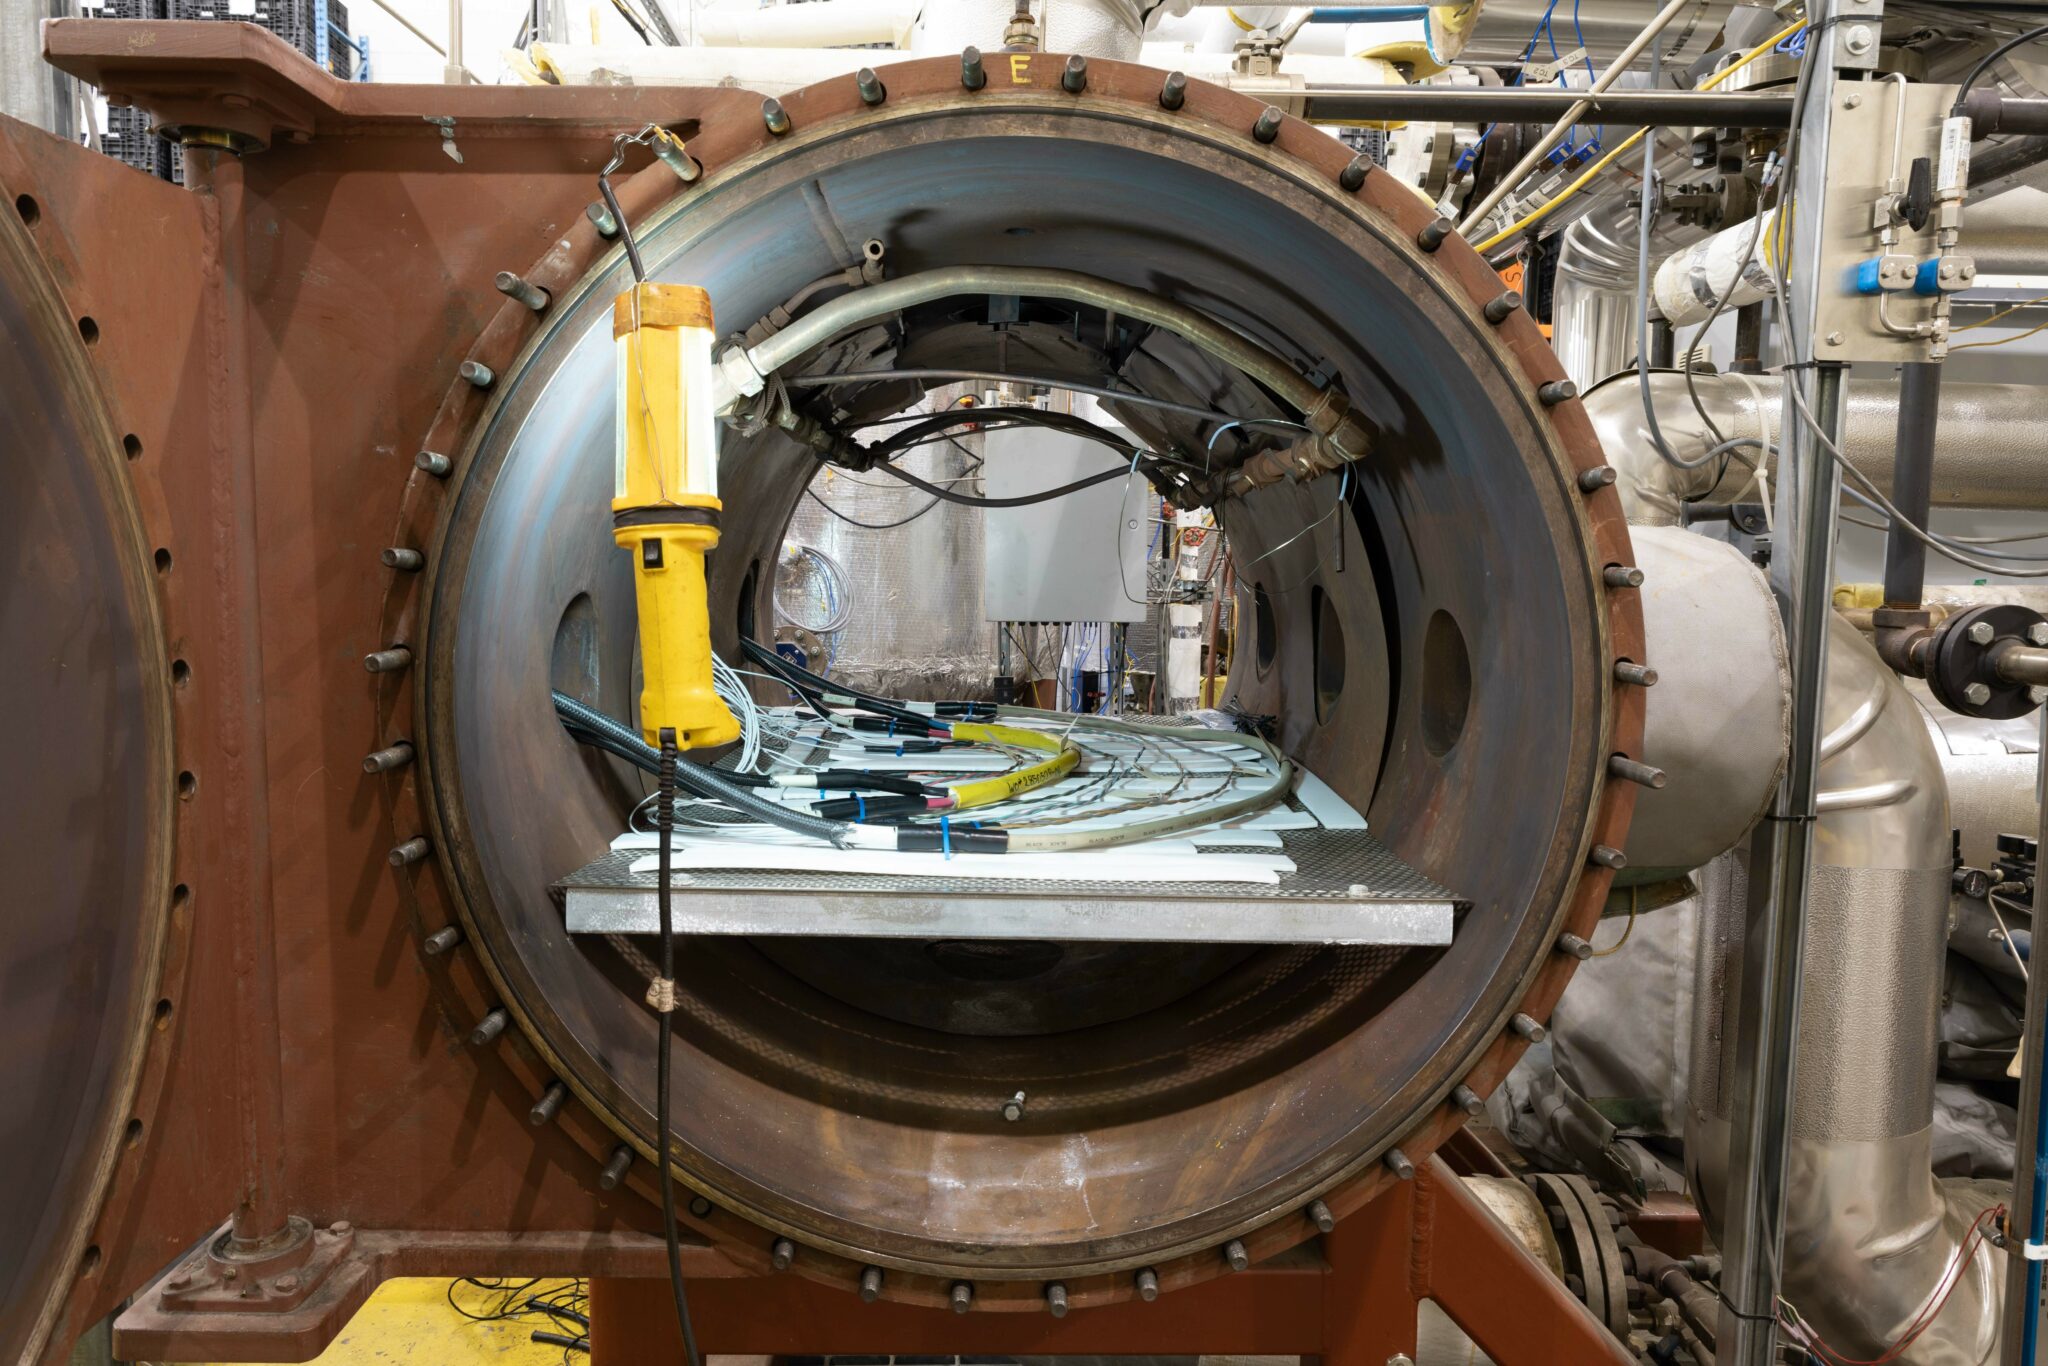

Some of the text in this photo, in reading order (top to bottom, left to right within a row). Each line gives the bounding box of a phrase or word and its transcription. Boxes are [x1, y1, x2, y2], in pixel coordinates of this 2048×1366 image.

[1562, 54, 1579, 65] TC3
[1010, 54, 1032, 84] E
[1533, 67, 1549, 77] TC2
